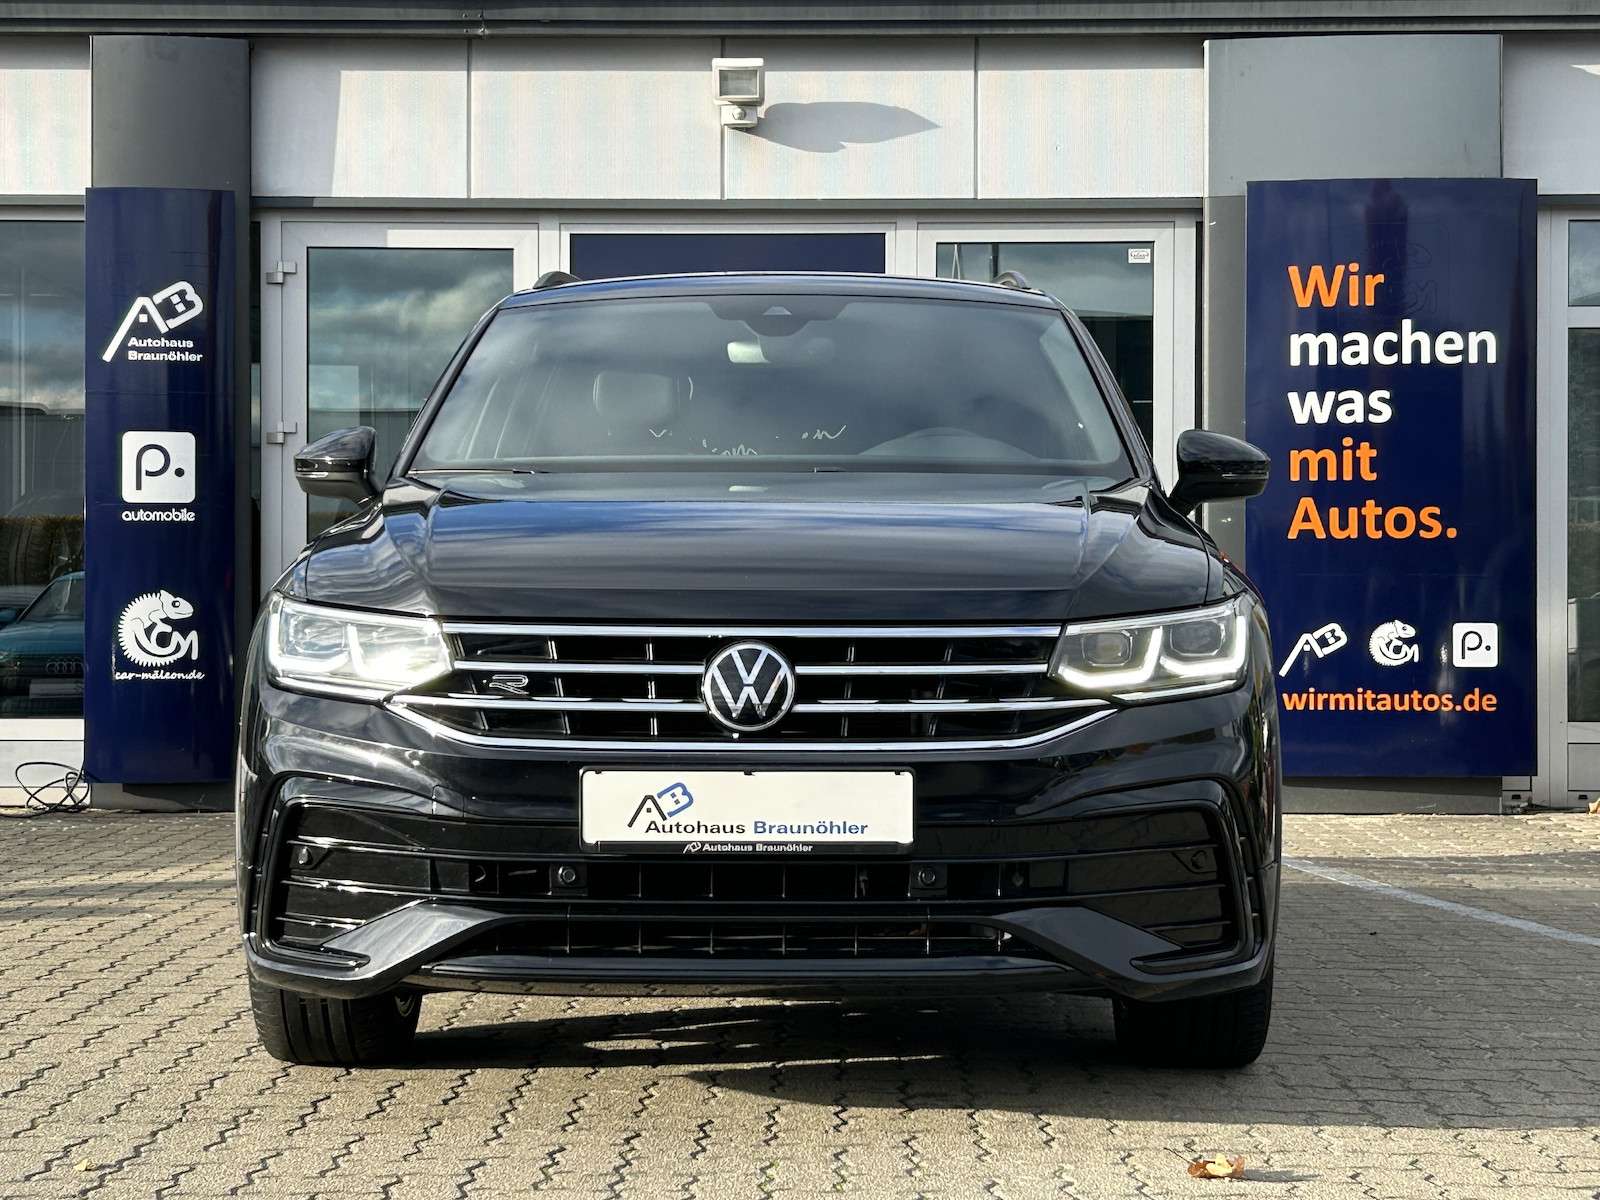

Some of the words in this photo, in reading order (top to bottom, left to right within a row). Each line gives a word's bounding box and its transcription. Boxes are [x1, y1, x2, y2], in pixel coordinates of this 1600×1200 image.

[1287, 262, 1385, 308] Wir
[128, 336, 194, 348] Autohaus
[1290, 318, 1497, 366] machen
[128, 350, 203, 362] Braunöhler
[1287, 389, 1393, 424] was
[1289, 437, 1378, 481] mit
[121, 508, 196, 522] automobile
[1286, 496, 1457, 539] Autos.
[1282, 687, 1498, 712] wirmitautos.de
[645, 820, 746, 835] Autohaus
[753, 819, 869, 835] Braunöhler
[703, 842, 753, 853] Autohaus
[755, 842, 814, 853] Braunöhler
